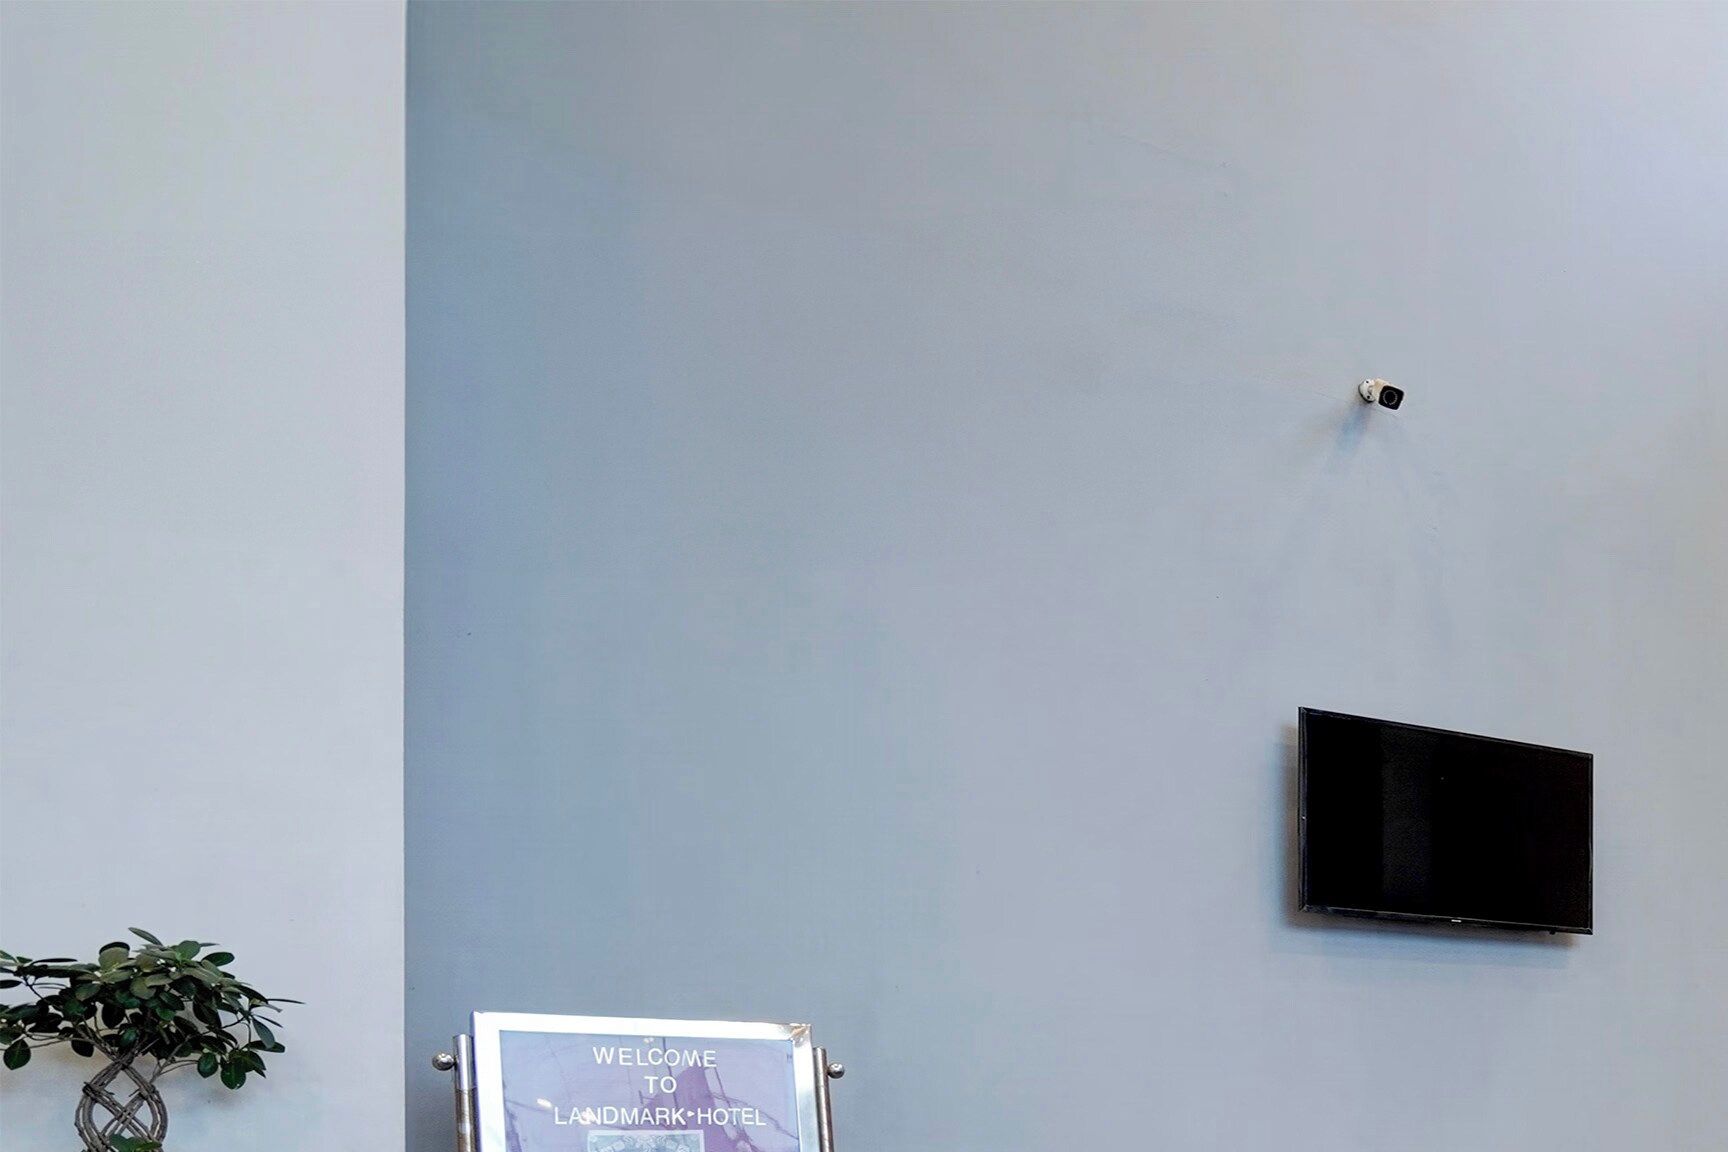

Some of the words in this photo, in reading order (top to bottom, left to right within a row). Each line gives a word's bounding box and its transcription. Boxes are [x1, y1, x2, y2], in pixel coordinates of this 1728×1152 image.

[592, 1046, 717, 1068] WELCOME
[644, 1075, 677, 1094] TO
[554, 1106, 687, 1126] LANDMARK
[697, 1107, 767, 1126] HOTEL
